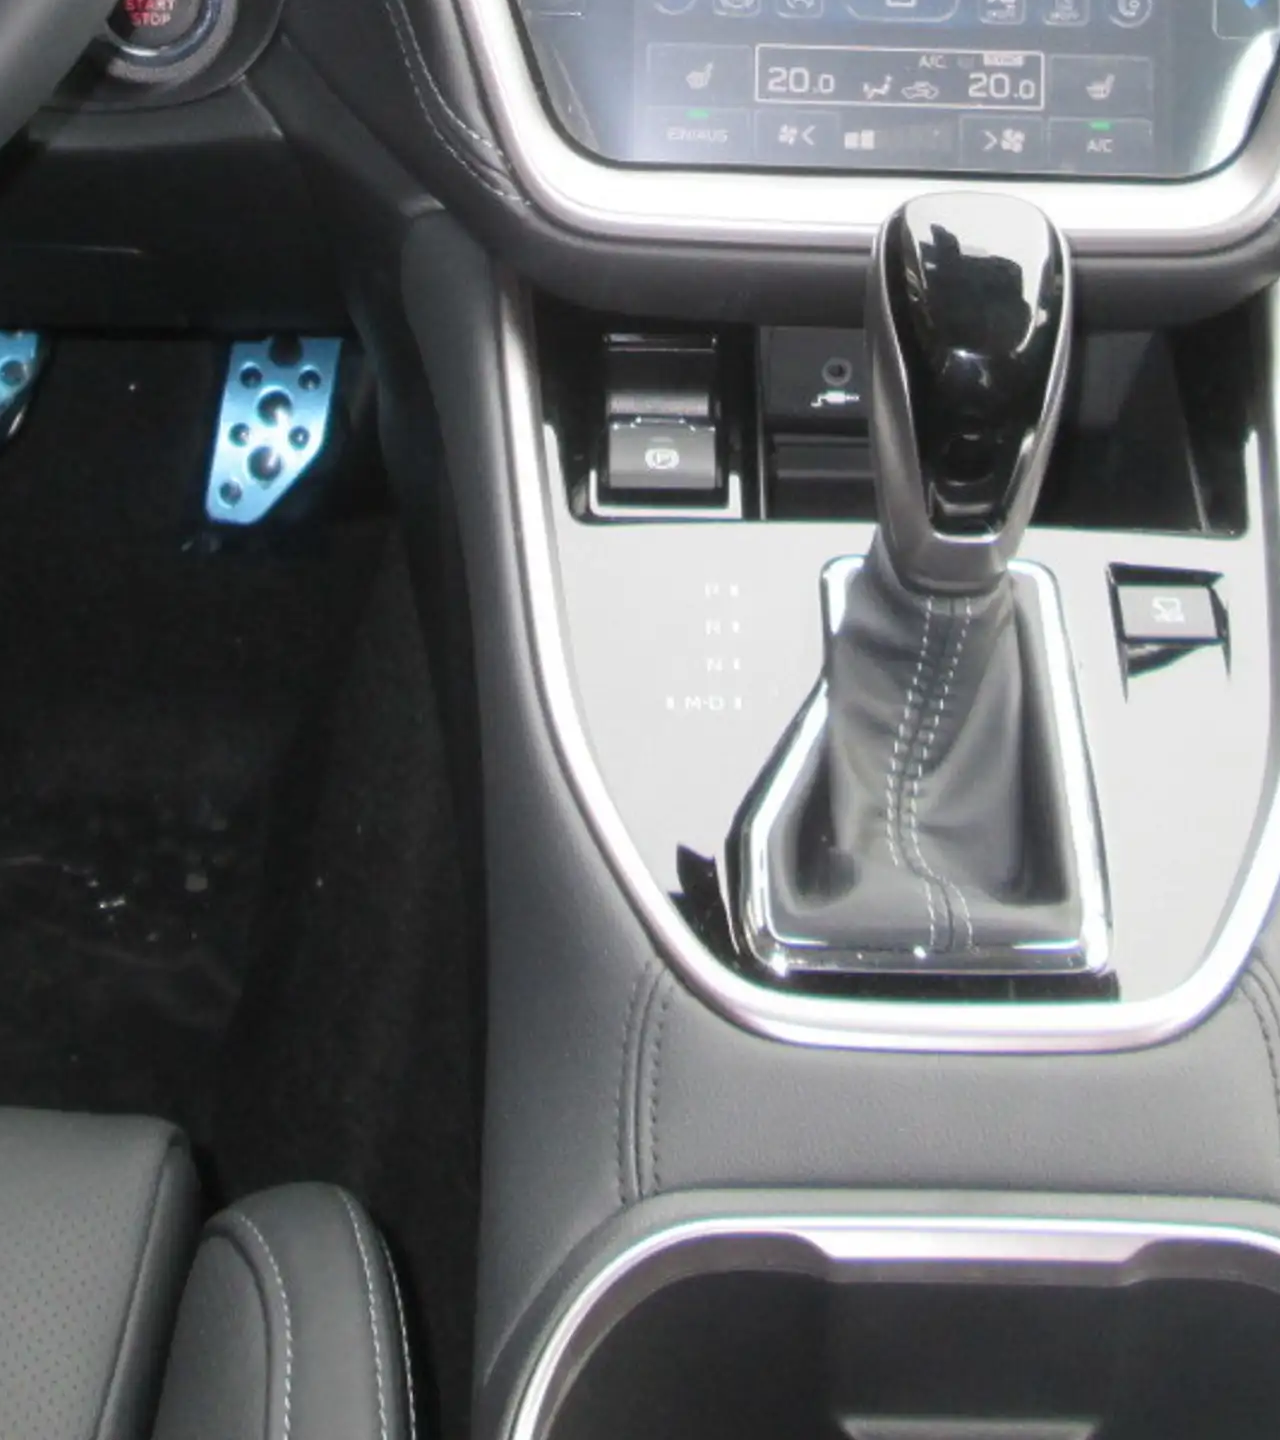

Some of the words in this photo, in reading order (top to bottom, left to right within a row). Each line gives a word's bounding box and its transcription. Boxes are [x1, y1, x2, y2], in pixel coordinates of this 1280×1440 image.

[131, 11, 172, 26] STOP
[967, 72, 1036, 100] 20.0
[1086, 138, 1113, 154] A/C
